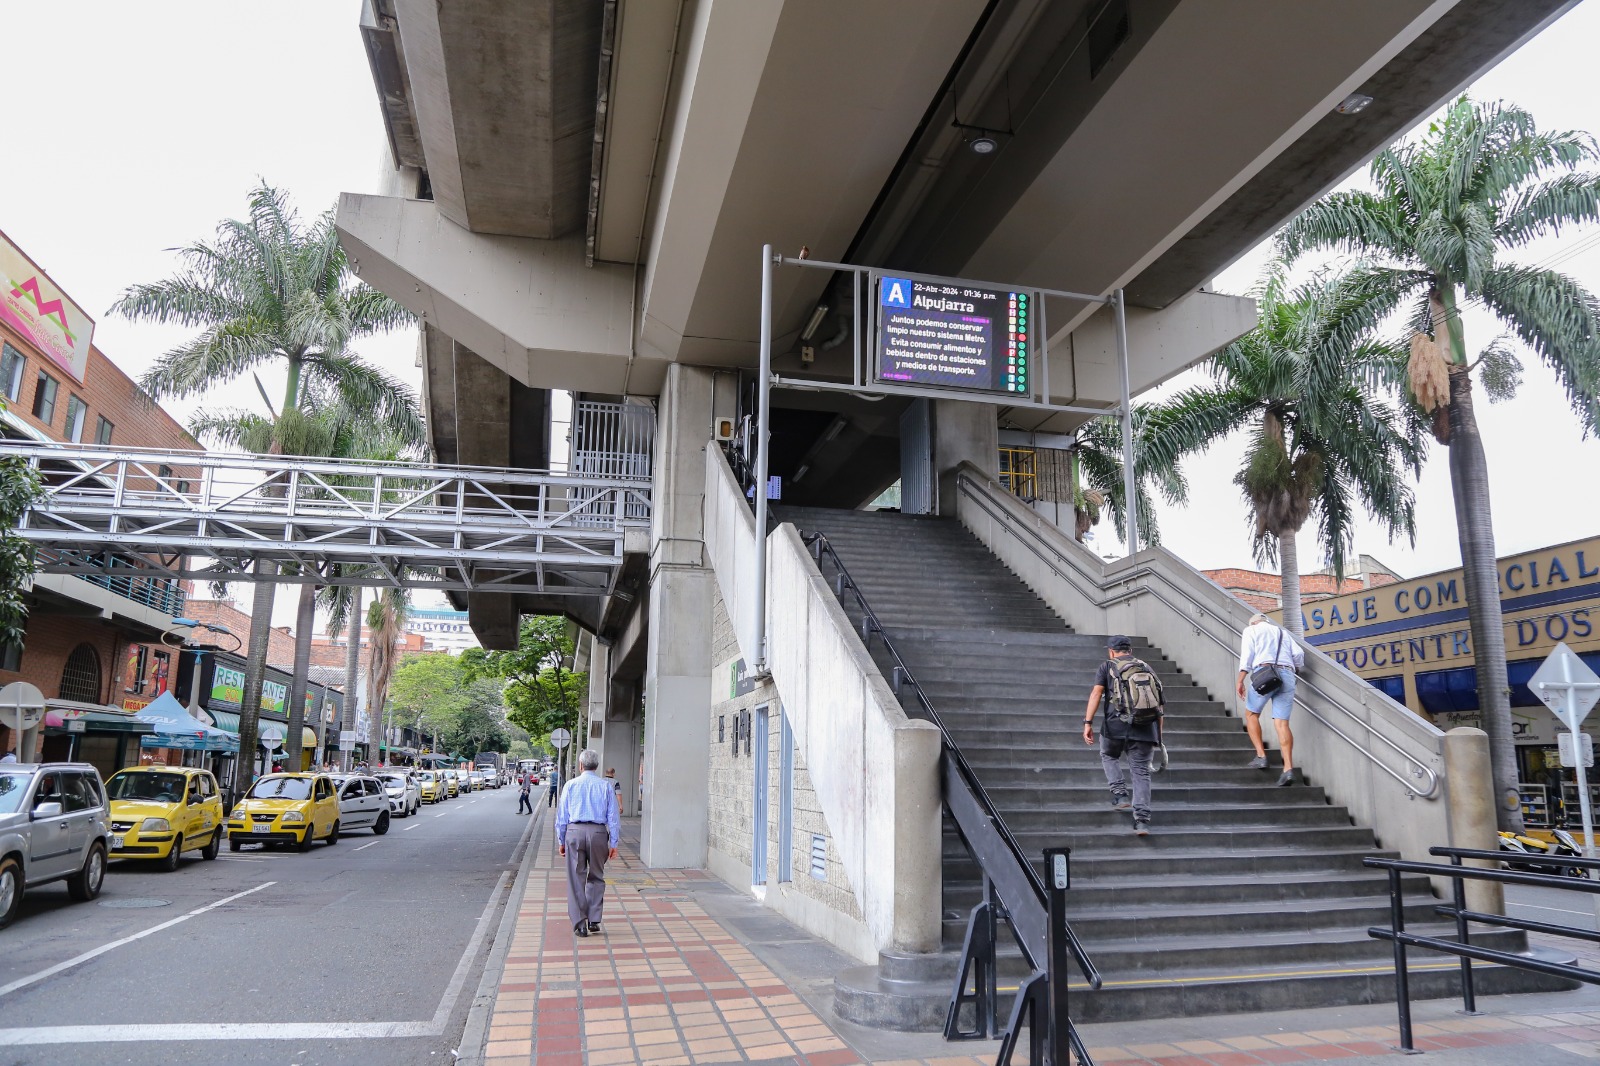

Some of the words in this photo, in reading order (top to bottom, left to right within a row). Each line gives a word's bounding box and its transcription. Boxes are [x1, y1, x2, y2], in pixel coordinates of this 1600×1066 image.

[888, 282, 905, 304] A
[963, 289, 982, 298] 01:36
[913, 294, 974, 313] Alpujarra
[890, 314, 915, 325] Juntos
[916, 318, 948, 329] podemos
[948, 322, 983, 332] conservar
[887, 324, 909, 336] limpio
[909, 328, 936, 338] nuestro
[937, 331, 964, 341] sistema
[964, 333, 987, 343] Metro.
[885, 347, 914, 359] bebidas
[914, 350, 939, 361] dentro
[938, 353, 949, 362] de
[949, 355, 987, 366] estaciones
[891, 337, 909, 348] Evita
[909, 340, 943, 351] consumir
[943, 343, 977, 354] alimentos
[977, 348, 983, 357] y
[895, 361, 902, 370] y
[901, 361, 928, 371] medios
[927, 363, 938, 372] de
[938, 363, 976, 376] transporte.
[1301, 595, 1378, 632] ASAJE
[1394, 550, 1599, 613] COMCIAL
[410, 622, 464, 632] HOLLYWOOD
[1516, 607, 1592, 647] DOS
[216, 667, 286, 699] RESTANTE
[224, 688, 240, 702] SOL
[124, 700, 141, 711] MEGA
